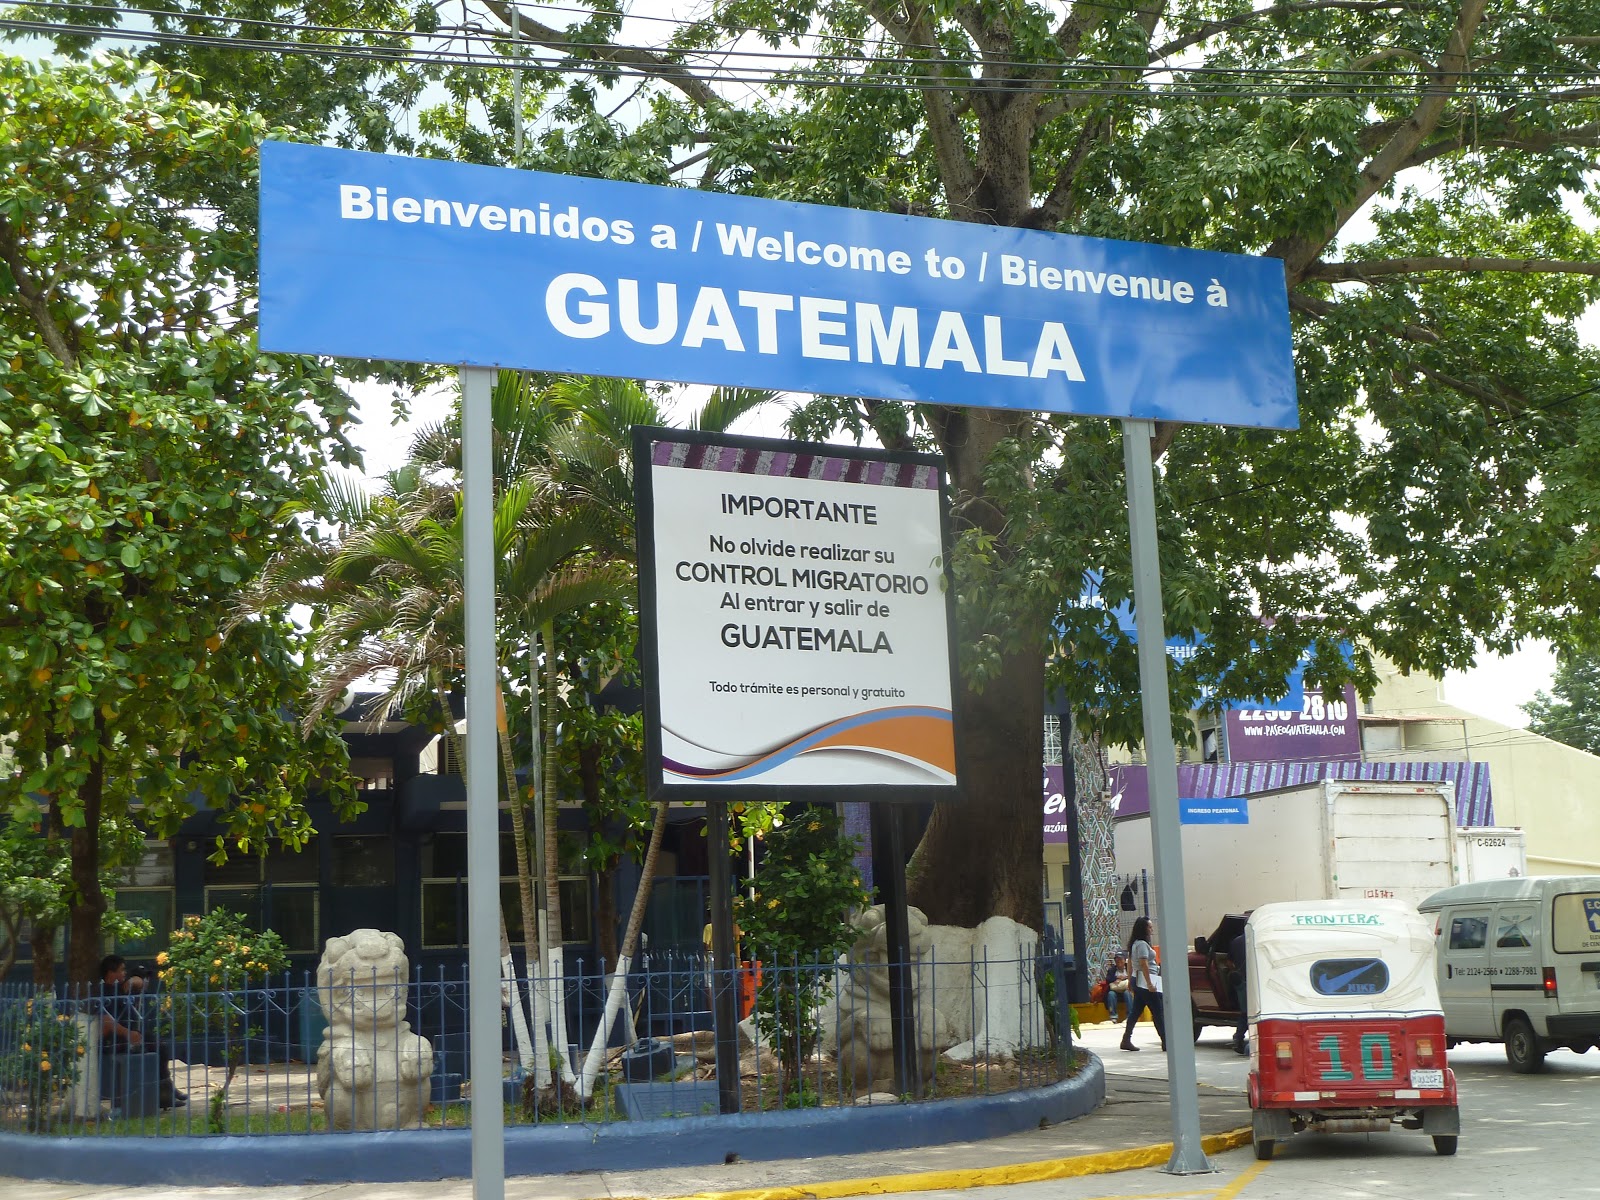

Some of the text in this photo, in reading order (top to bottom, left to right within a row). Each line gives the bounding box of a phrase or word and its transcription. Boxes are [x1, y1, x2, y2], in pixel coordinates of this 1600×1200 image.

[340, 184, 1229, 307] Bienvenidos a / Welcome to / Bienvenue à
[545, 272, 1086, 383] GUATEMALA
[721, 493, 878, 526] IMPORTANTE
[709, 535, 895, 564] No olvide realizar su
[675, 561, 929, 595] CONTROL MIGRATORIO
[720, 592, 890, 618] Al entrar y salir de
[720, 623, 894, 655] GUATEMALA
[709, 681, 906, 701] Todo trámite es personal y gratuito
[1477, 838, 1506, 847] C-62624
[1347, 983, 1377, 993] NIKE
[1319, 1033, 1393, 1081] 10
